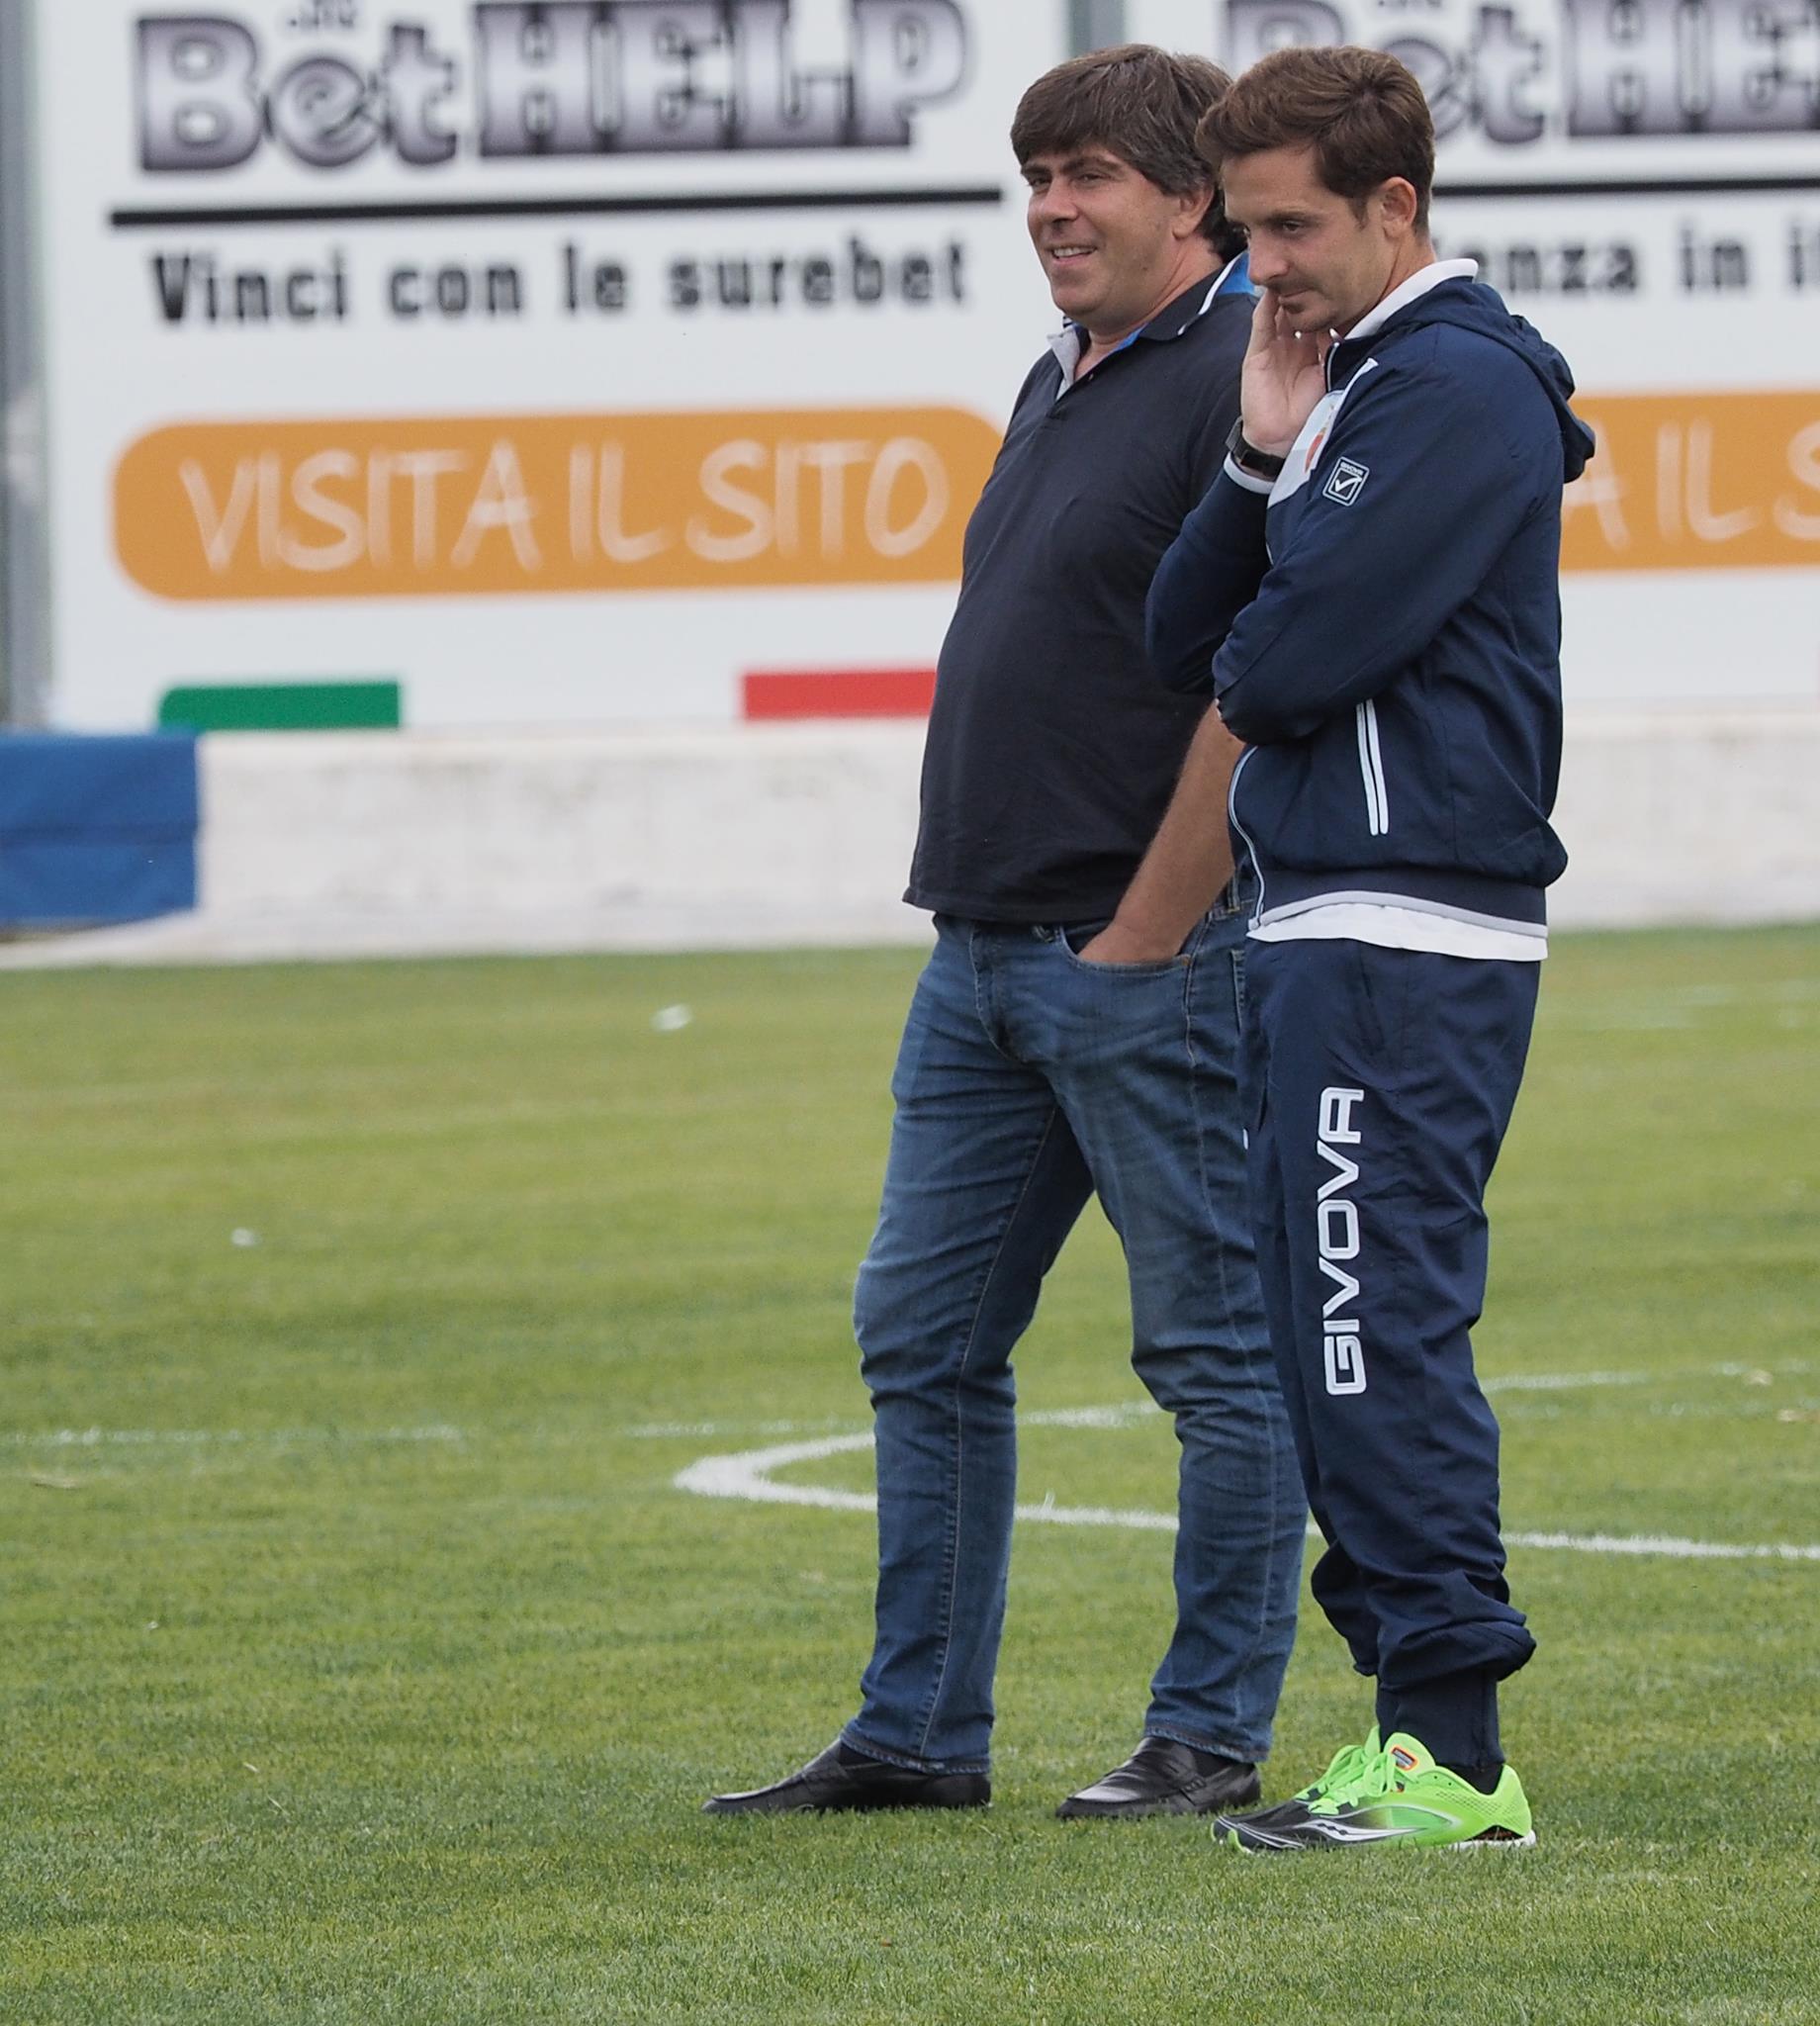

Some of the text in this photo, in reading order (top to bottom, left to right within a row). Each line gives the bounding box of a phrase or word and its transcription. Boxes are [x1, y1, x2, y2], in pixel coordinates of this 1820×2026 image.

[150, 235, 967, 323] Vinci con le surebet
[1680, 220, 1749, 291] in
[181, 435, 952, 572] VISITA IL SITO
[1656, 419, 1759, 544] IL
[1317, 1086, 1367, 1396] GIVOVA
